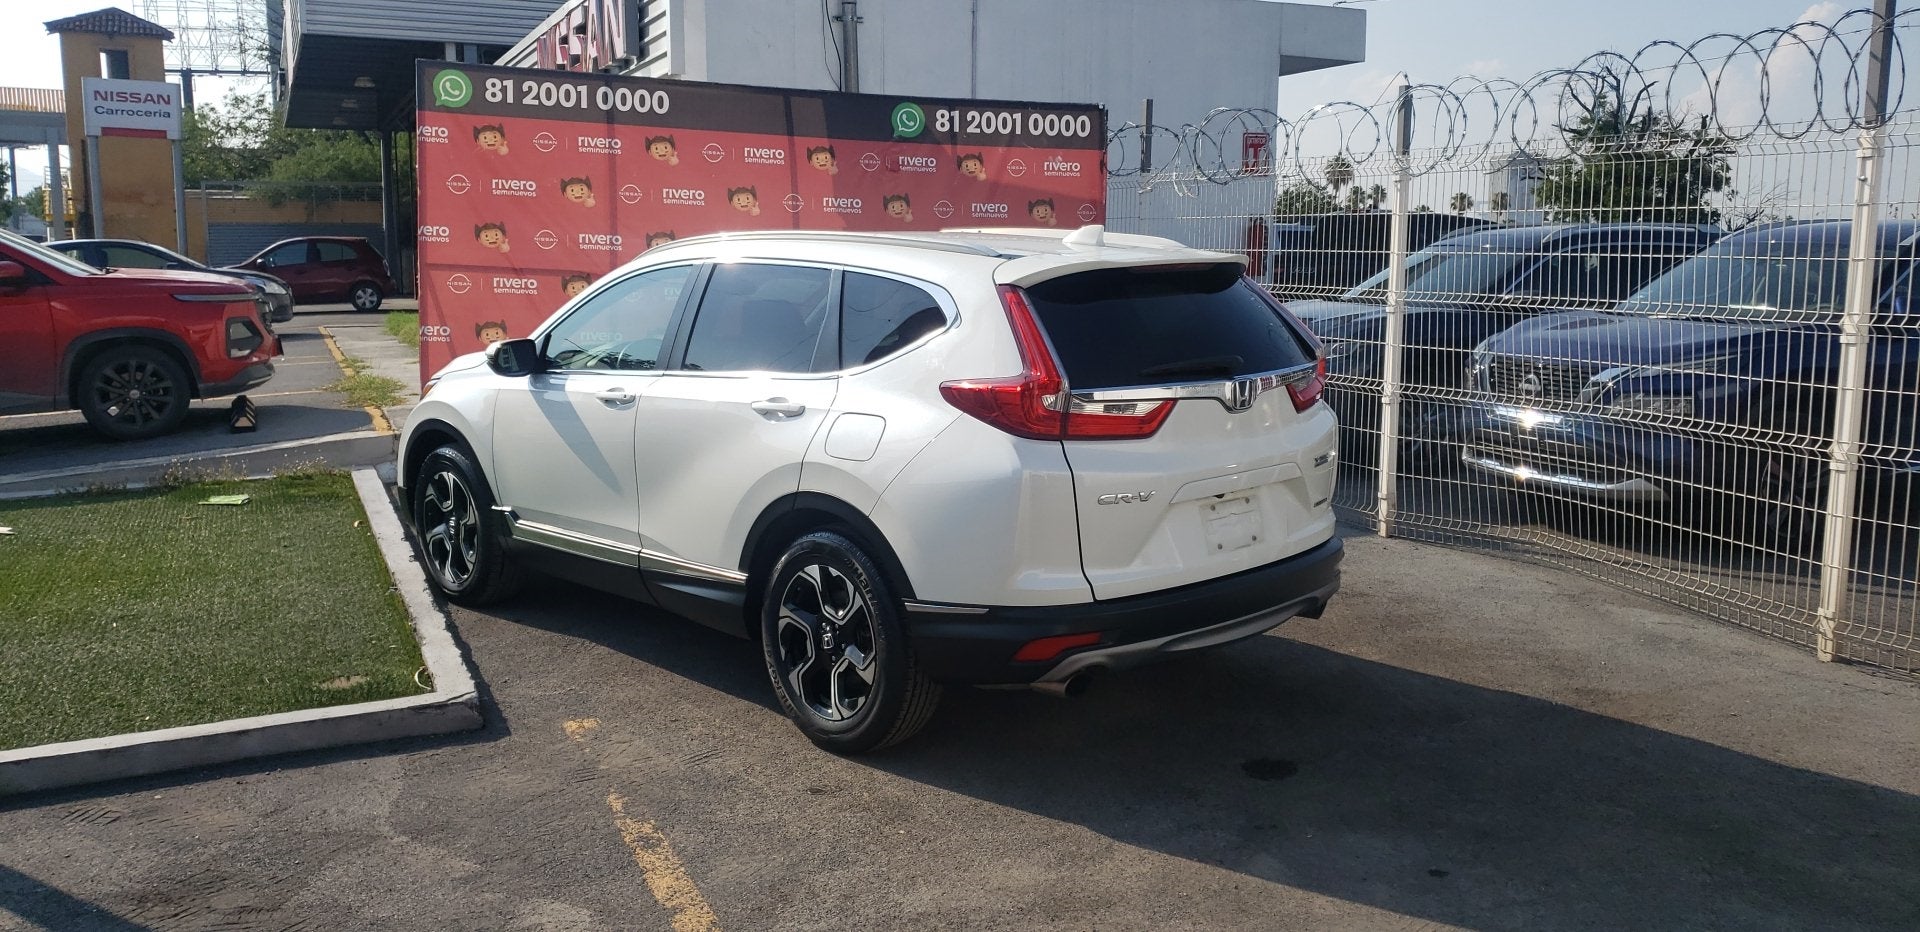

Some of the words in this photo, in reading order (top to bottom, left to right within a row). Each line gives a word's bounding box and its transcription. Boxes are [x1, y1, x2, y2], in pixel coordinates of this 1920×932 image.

[93, 90, 171, 105] NISSAN
[485, 78, 513, 104] 81
[522, 81, 588, 109] 2001
[596, 86, 669, 115] 0000
[94, 105, 171, 118] Carroceria
[935, 109, 960, 133] 81
[966, 110, 1022, 135] 2001
[1028, 113, 1091, 138] 0000
[578, 136, 622, 149] rivero
[578, 147, 622, 155] seminuevos
[744, 147, 785, 159] rivero
[744, 157, 785, 165] seminuevos
[899, 156, 937, 167] rivero
[1044, 160, 1081, 172] rivero
[492, 178, 537, 191] rivero
[492, 189, 537, 197] seminuevos
[662, 188, 705, 200] rivero
[663, 198, 705, 206] seminuevos
[823, 197, 862, 208] rivero
[971, 202, 1008, 213] rivero
[823, 206, 862, 214] seminuevos
[972, 211, 1008, 219] seminuevos
[578, 233, 622, 245] rivero
[579, 243, 622, 251] seminuevos
[493, 277, 538, 289] rivero
[494, 287, 538, 295] seminuevos
[1098, 490, 1156, 505] CR-V
